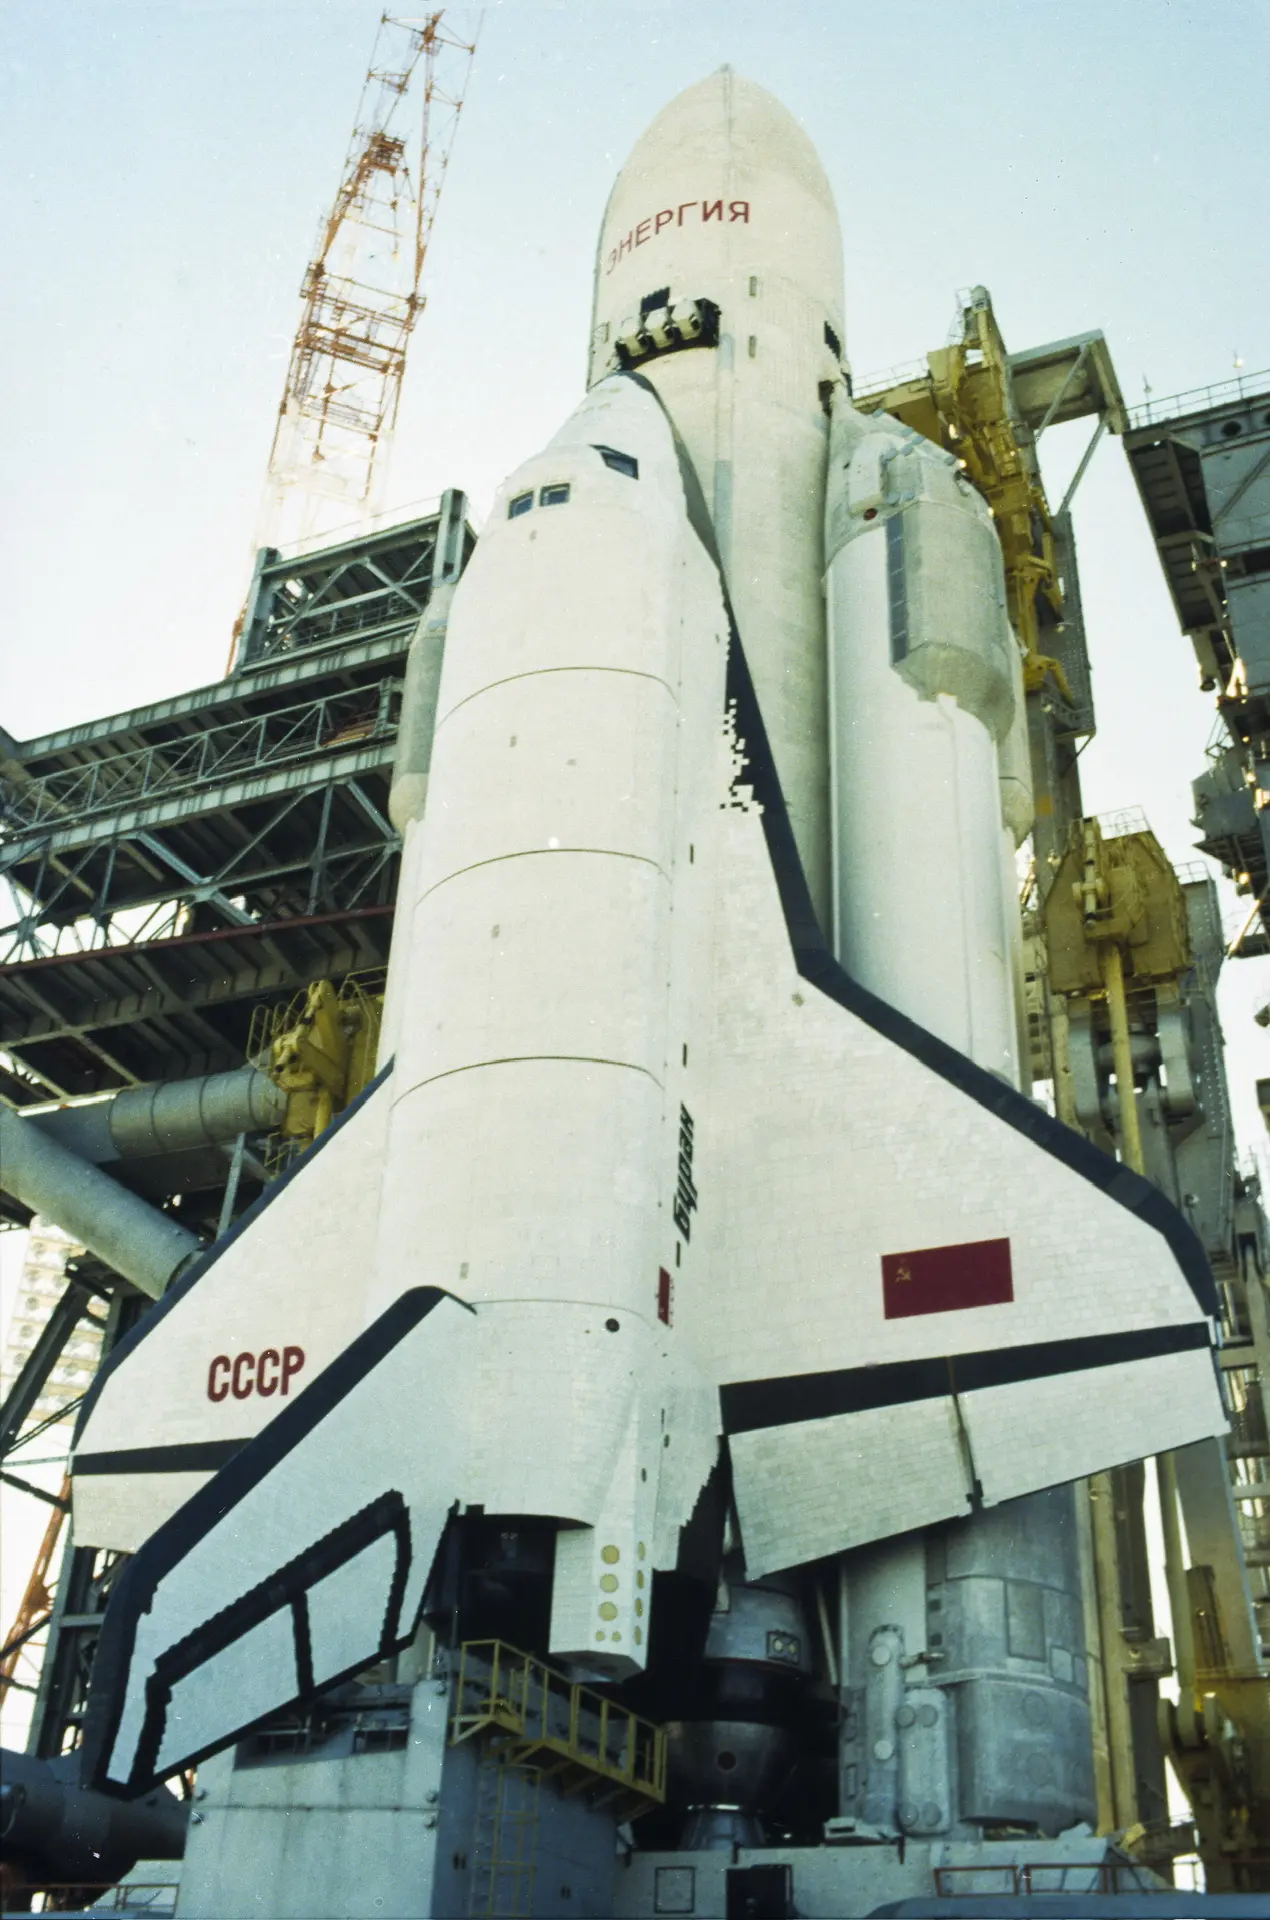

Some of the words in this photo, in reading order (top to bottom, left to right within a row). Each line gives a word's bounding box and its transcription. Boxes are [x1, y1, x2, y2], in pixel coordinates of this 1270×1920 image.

[606, 199, 750, 275] ЭНЕРГИЯ
[673, 1101, 698, 1244] Буран
[207, 1346, 305, 1402] СССР
